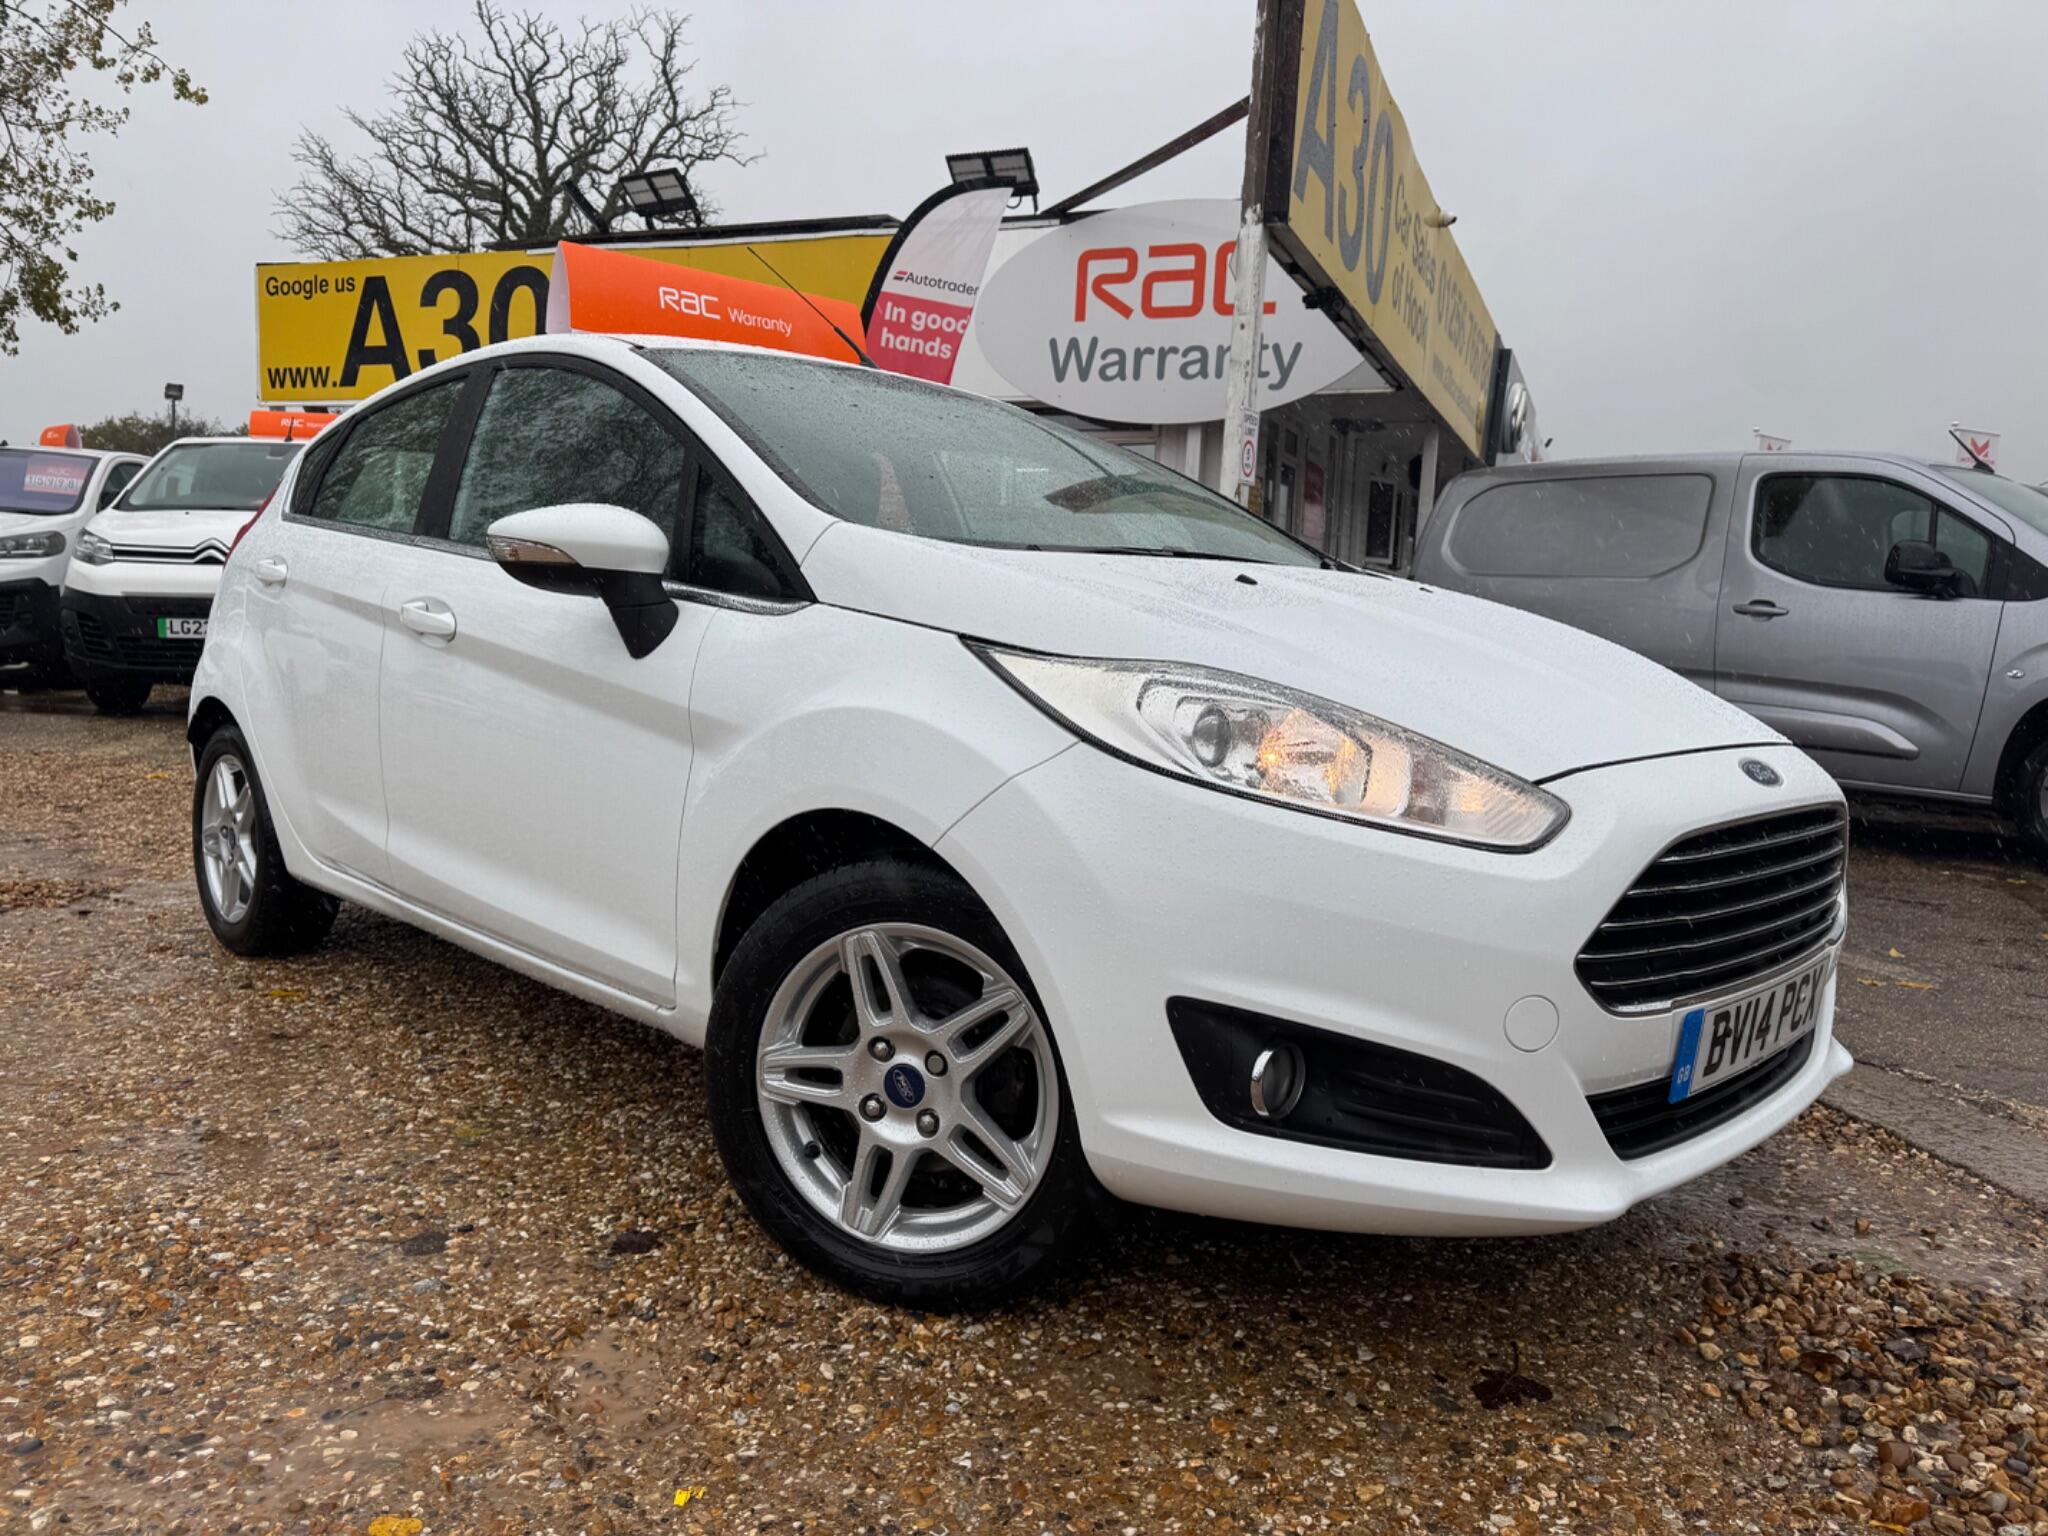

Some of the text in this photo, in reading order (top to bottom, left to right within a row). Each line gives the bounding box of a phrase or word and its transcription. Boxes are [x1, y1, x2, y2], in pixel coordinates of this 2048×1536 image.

[1293, 0, 1394, 304] A30
[265, 274, 356, 300] Google us
[905, 272, 979, 296] Autotrader
[727, 307, 793, 337] Warranty
[884, 301, 906, 323] In
[880, 326, 952, 359] hands
[1703, 965, 1823, 1078] BV14 PCX
